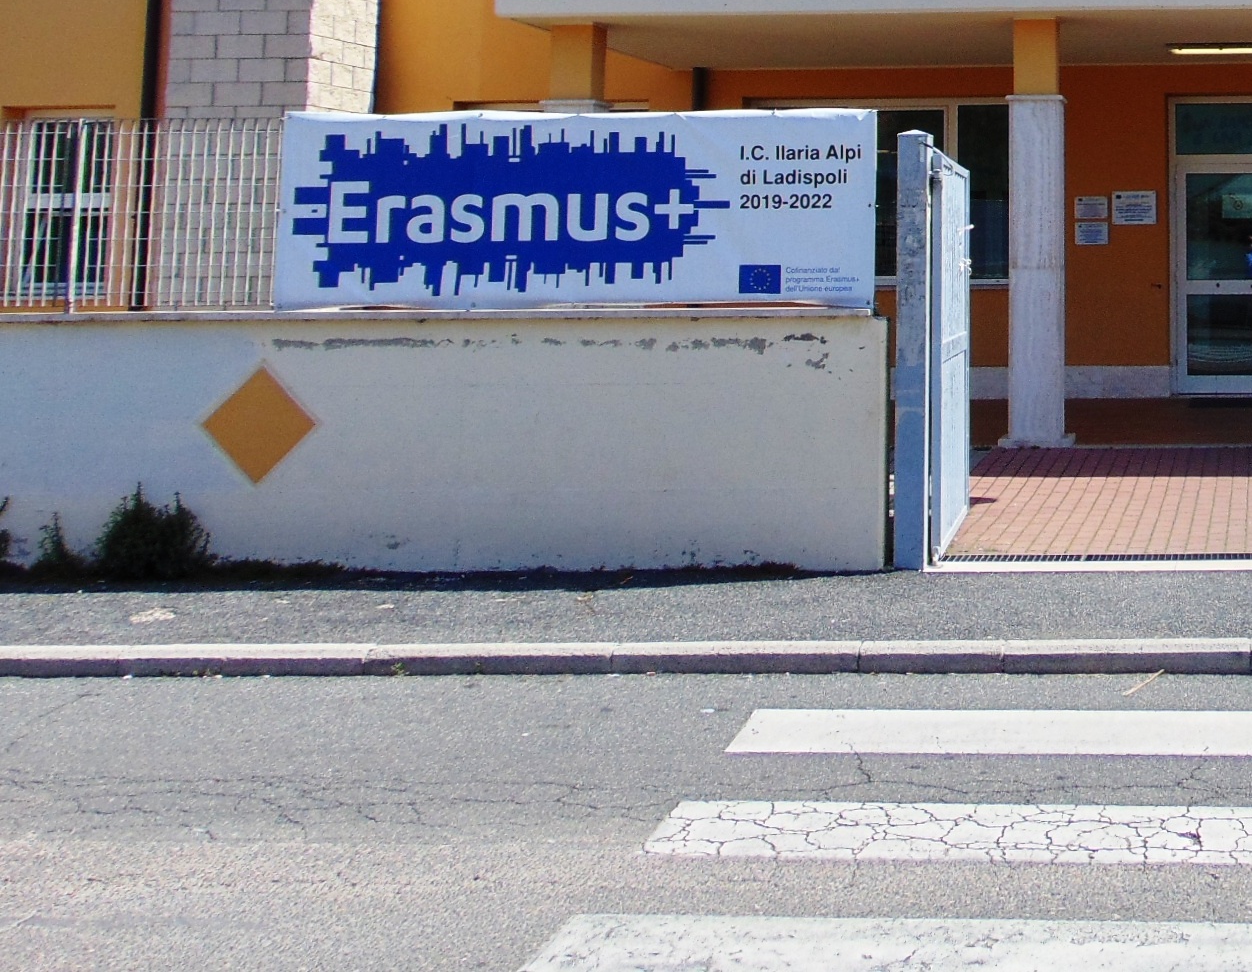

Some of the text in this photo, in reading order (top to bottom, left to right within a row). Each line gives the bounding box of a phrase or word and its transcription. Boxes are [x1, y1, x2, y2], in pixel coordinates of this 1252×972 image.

[740, 143, 861, 163] I.C. Ilaria Alpi
[740, 168, 848, 188] di Ladispoli
[739, 193, 832, 209] 2019-2022
[328, 181, 694, 244] Erasmus+
[826, 275, 860, 283] Erasmus+
